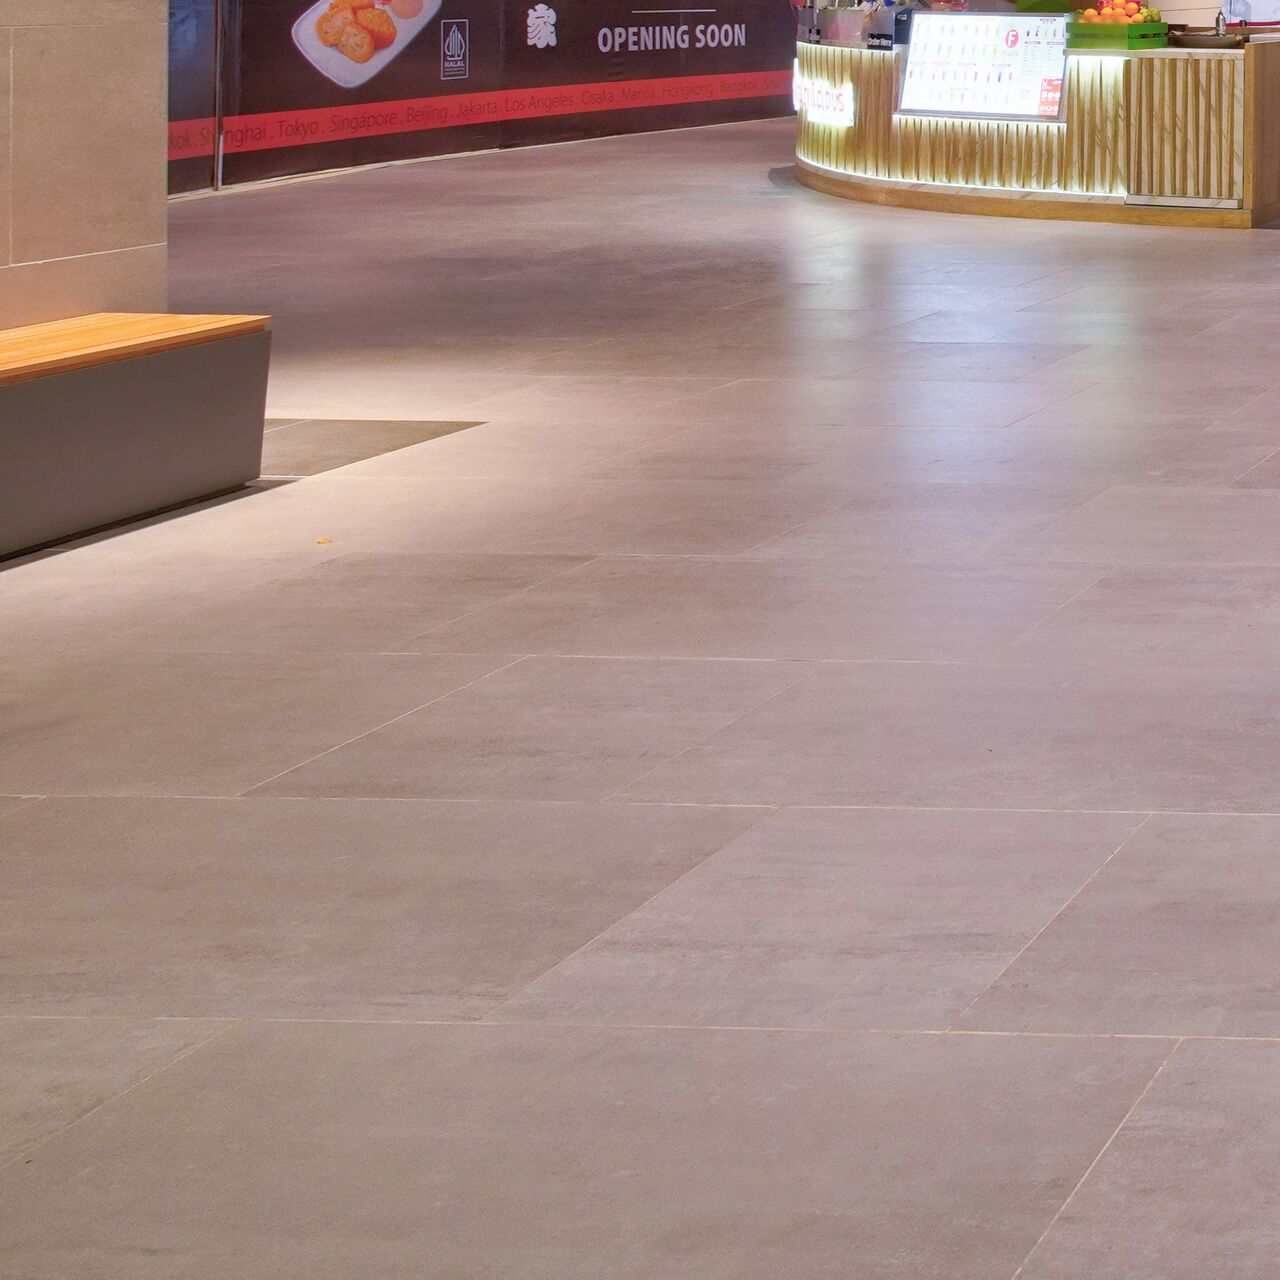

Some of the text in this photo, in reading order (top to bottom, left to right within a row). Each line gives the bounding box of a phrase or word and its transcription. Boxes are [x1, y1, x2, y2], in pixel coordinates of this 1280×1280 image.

[598, 23, 746, 53] OPENING SOON
[200, 126, 267, 148] Shnghai
[278, 120, 319, 142] Tokyo
[331, 114, 397, 139] Singapore
[406, 104, 449, 124] Beijing
[457, 98, 497, 118] Jakarta
[505, 97, 526, 111] Los
[530, 93, 573, 117] Angeles
[581, 90, 615, 106] Osaka
[662, 83, 714, 104] Hongkong
